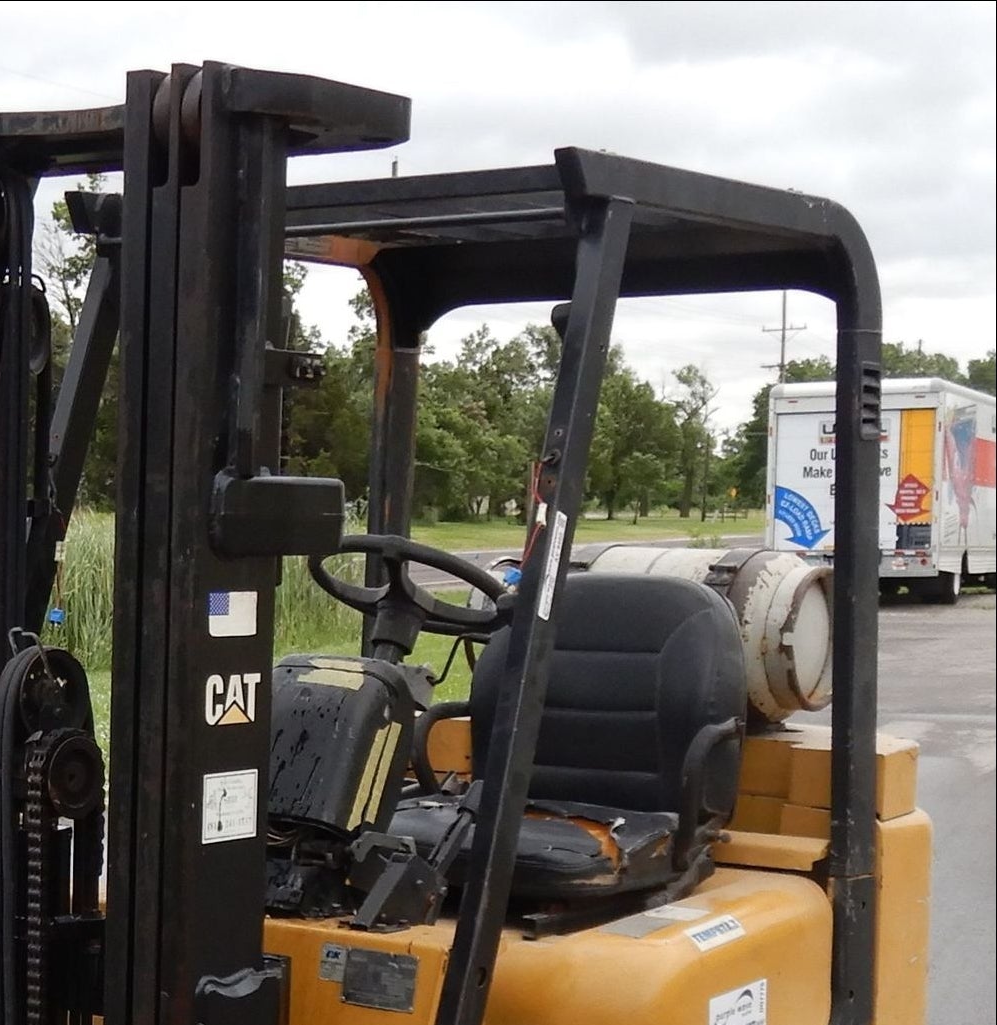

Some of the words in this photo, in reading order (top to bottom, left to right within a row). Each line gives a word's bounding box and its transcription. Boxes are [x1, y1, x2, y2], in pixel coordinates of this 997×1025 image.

[809, 448, 828, 461] Our
[803, 466, 833, 479] Make
[205, 672, 261, 726] CAT
